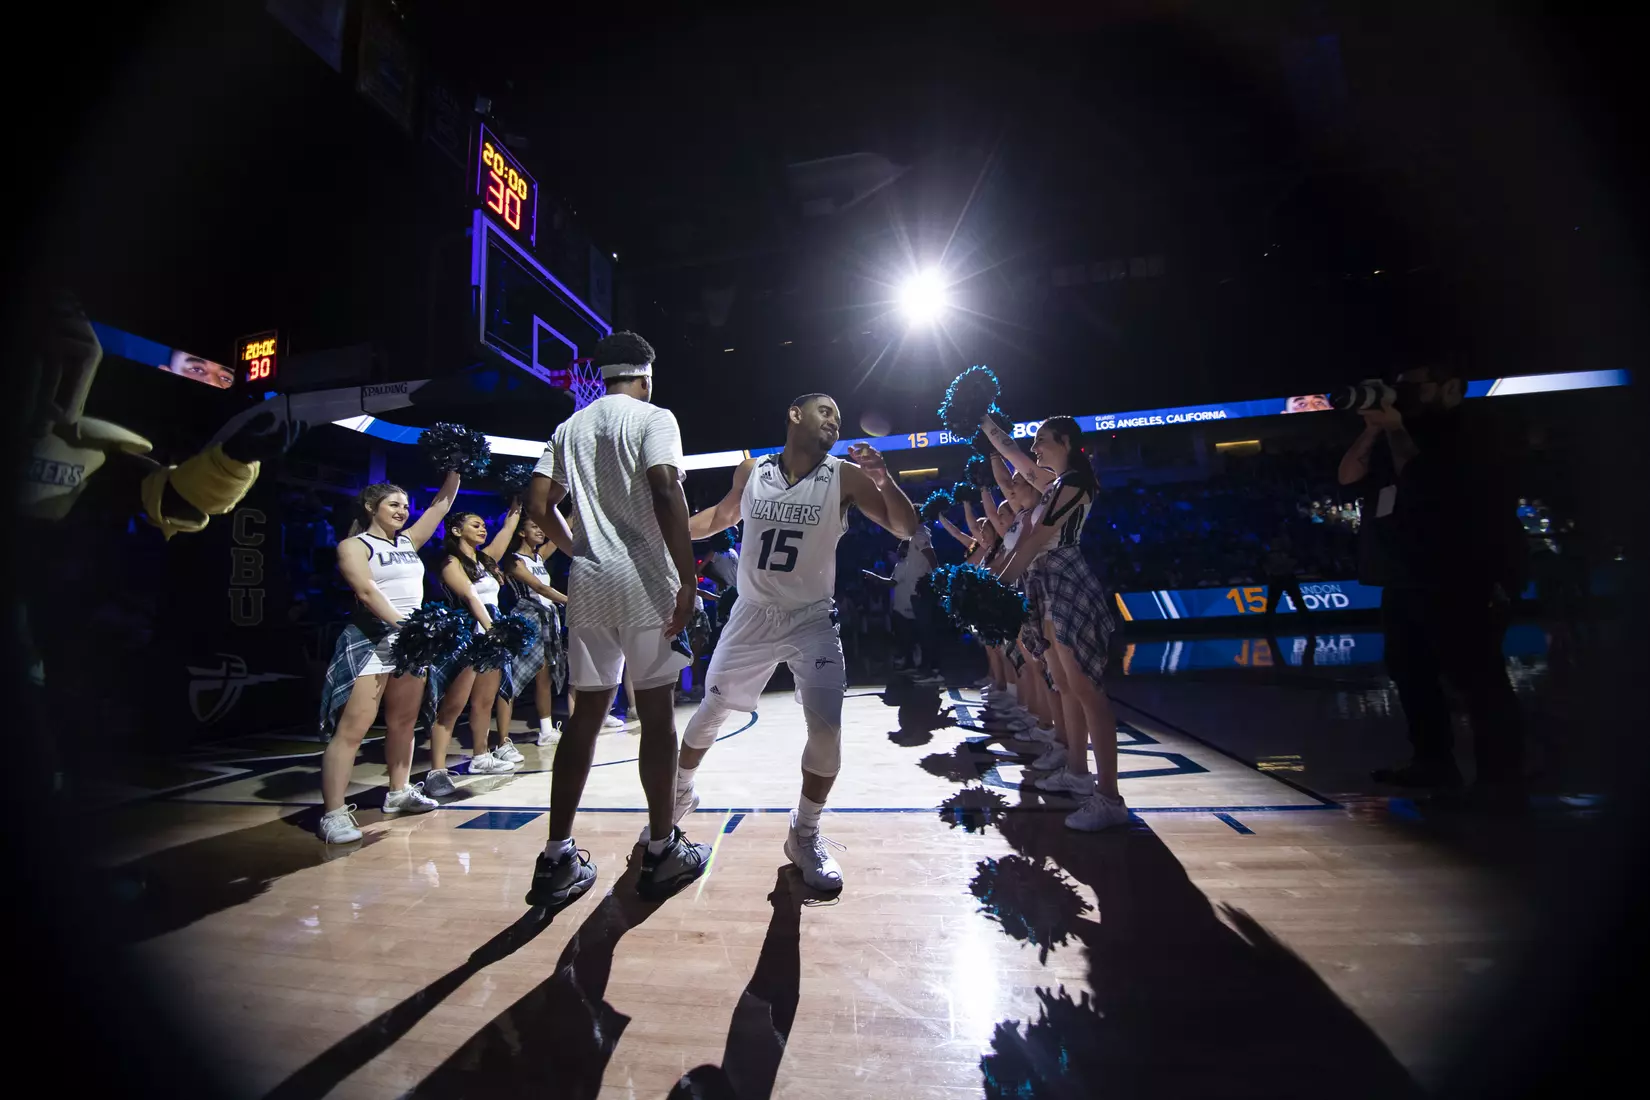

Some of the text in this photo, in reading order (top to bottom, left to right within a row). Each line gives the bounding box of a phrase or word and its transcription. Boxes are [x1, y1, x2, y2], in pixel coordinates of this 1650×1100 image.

[483, 142, 527, 200] 20:00
[487, 170, 521, 230] 30
[250, 357, 271, 380] 30
[1095, 410, 1227, 431] LOS ANGELES, CALIFORNIA
[907, 432, 929, 449] 15
[751, 499, 821, 526] LANCERS
[757, 528, 804, 573] 15
[228, 507, 266, 626] CBU
[1226, 587, 1268, 613] 15
